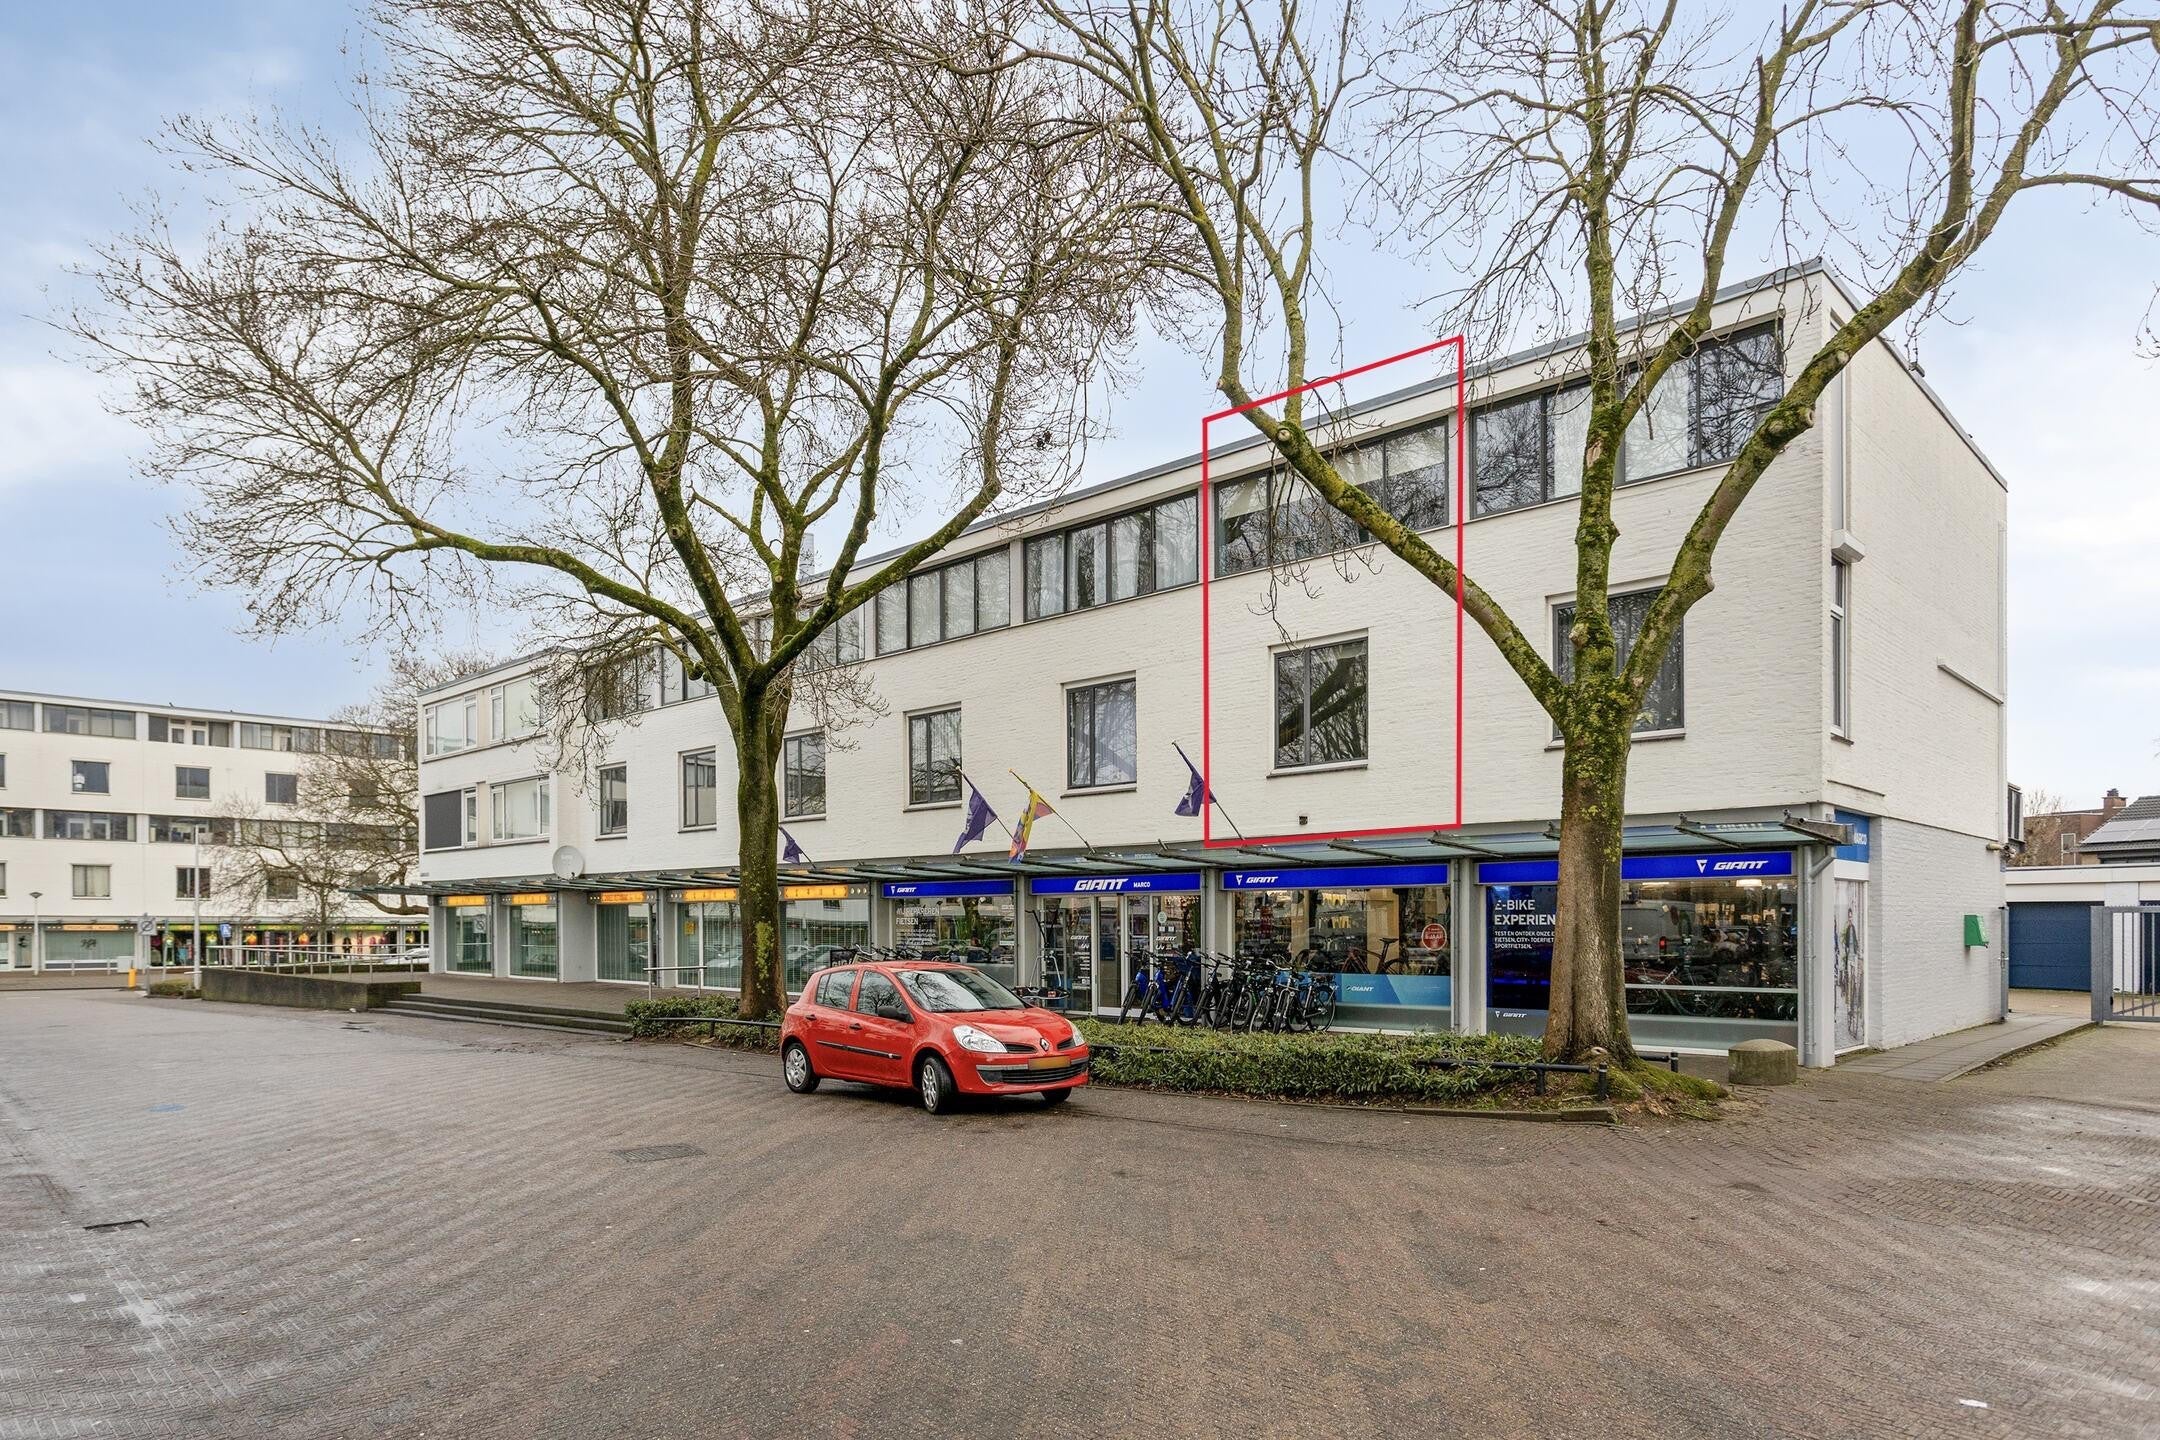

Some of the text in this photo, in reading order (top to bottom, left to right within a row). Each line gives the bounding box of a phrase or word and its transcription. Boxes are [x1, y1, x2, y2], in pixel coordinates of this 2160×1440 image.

[1713, 860, 1769, 871] GIANT
[1246, 876, 1279, 884] GIANT
[1074, 879, 1129, 891] GIANT
[896, 917, 919, 925] FIETSEN
